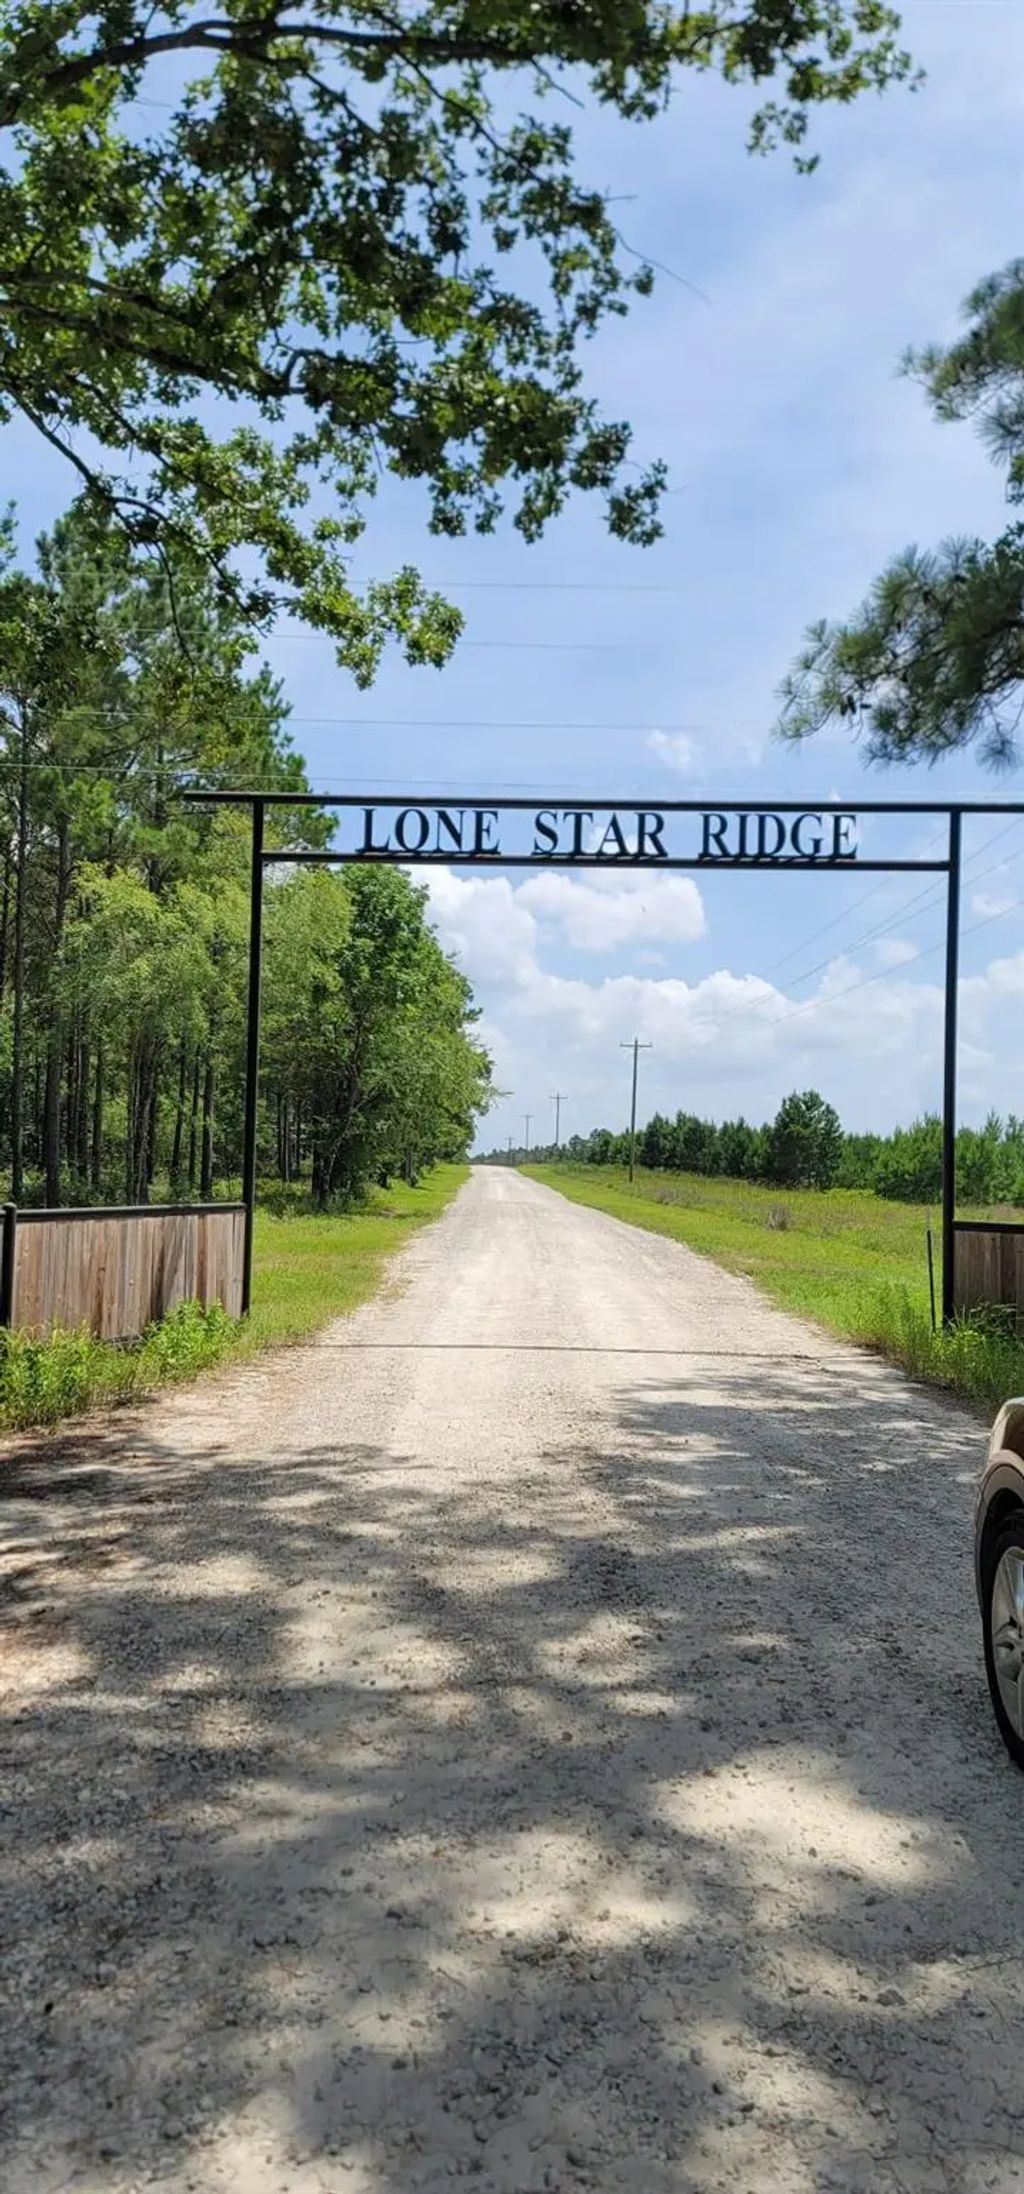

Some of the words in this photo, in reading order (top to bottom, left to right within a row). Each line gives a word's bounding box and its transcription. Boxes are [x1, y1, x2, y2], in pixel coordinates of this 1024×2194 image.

[355, 808, 500, 853] LONE
[532, 811, 667, 856] STAR
[698, 813, 858, 858] RIDGE
